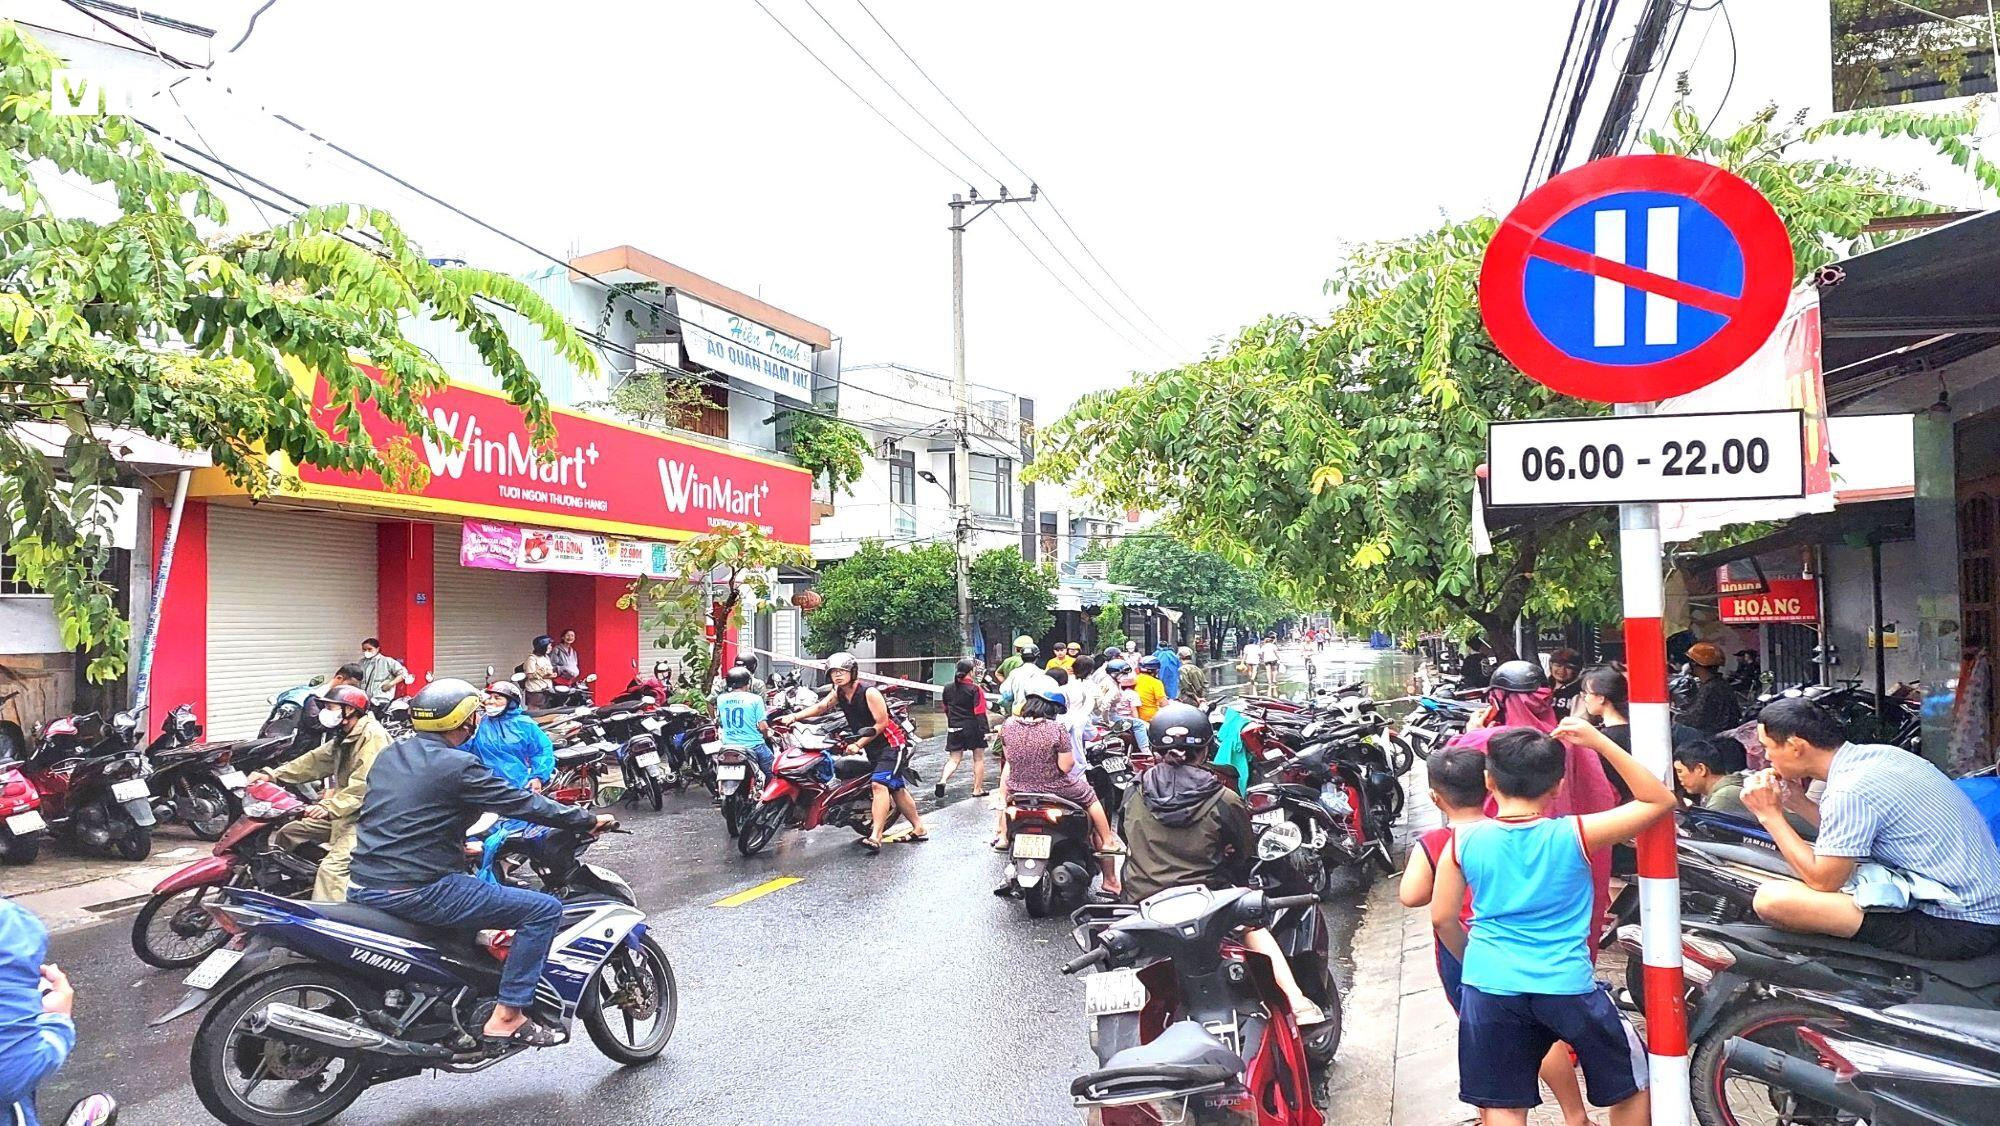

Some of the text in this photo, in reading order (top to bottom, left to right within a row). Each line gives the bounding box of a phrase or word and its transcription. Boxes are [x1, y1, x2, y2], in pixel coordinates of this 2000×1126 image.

[763, 359, 790, 383] NAM
[1521, 443, 1624, 482] 06.00
[1661, 437, 1770, 477] 22.00
[1733, 596, 1801, 616] HOÀNG
[724, 707, 745, 729] 10
[1742, 836, 1777, 851] YAMAHA
[350, 947, 412, 976] YAMAHA
